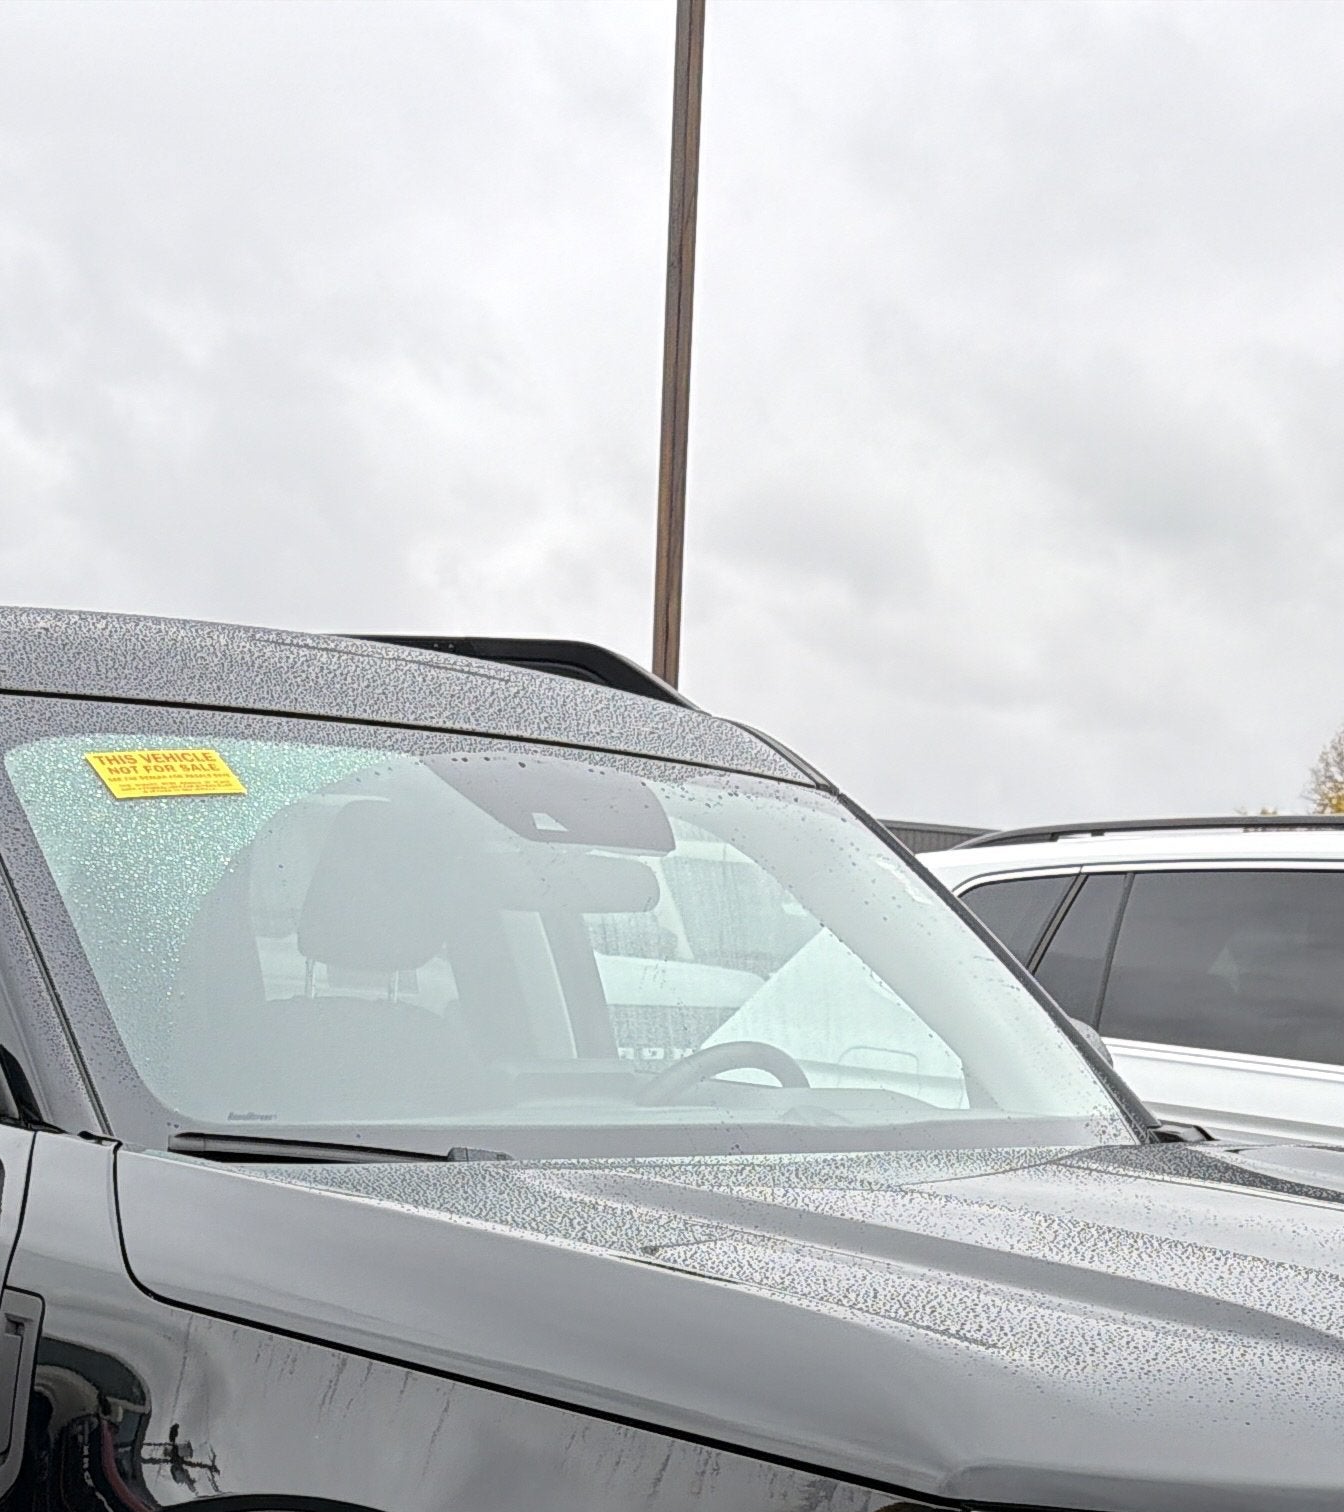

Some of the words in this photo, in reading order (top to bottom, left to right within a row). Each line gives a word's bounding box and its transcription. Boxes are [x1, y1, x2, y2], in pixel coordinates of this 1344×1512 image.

[93, 754, 138, 766] THIS
[138, 752, 216, 764] VEHICLE
[107, 766, 139, 775] NOT
[143, 764, 176, 774] FOR
[180, 763, 220, 772] SALE
